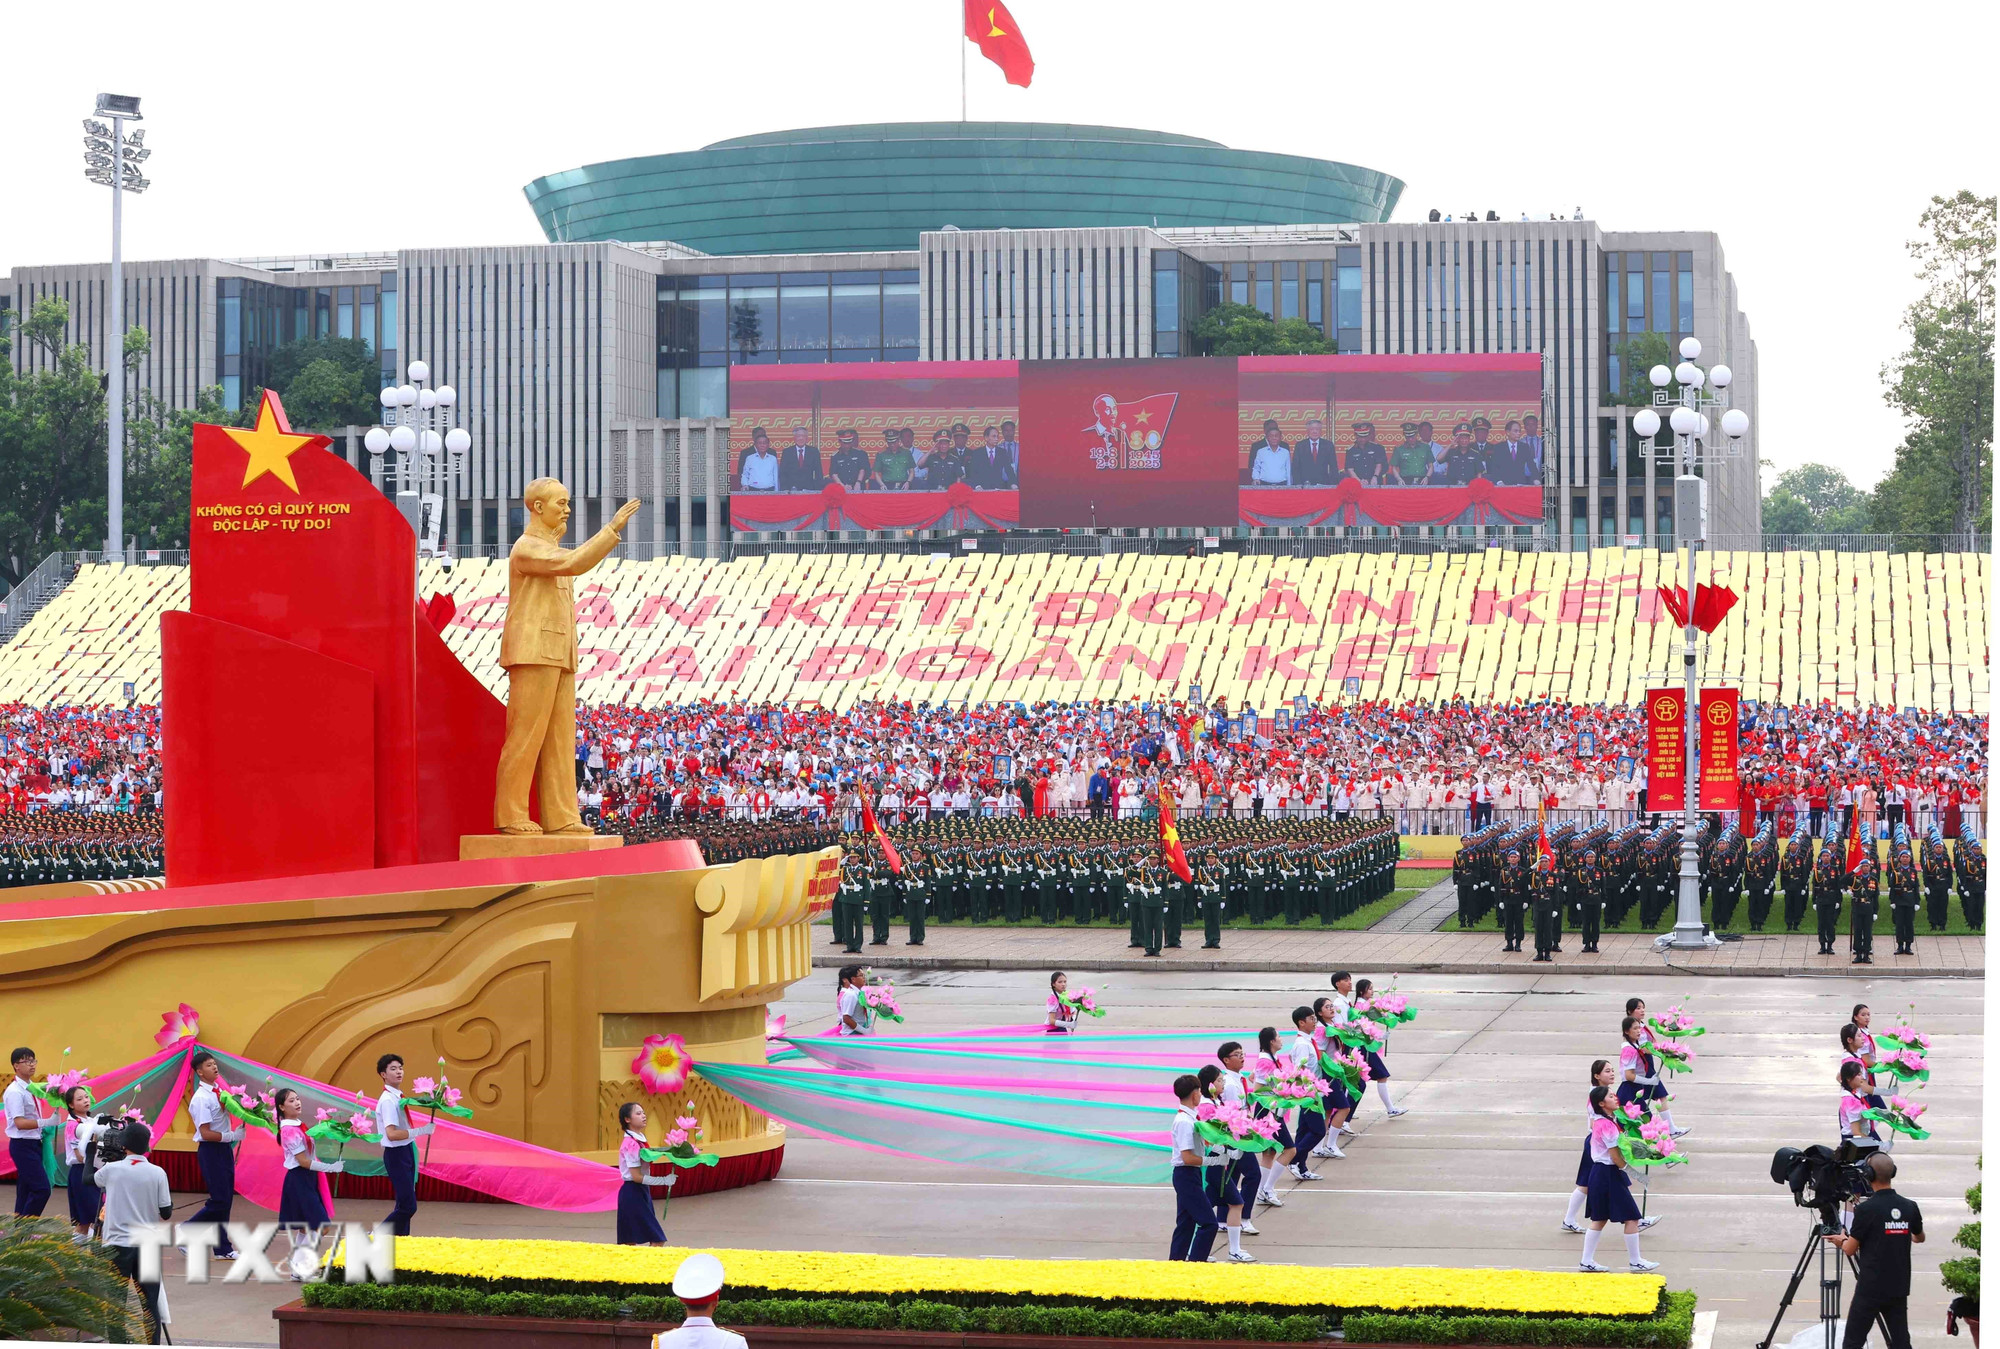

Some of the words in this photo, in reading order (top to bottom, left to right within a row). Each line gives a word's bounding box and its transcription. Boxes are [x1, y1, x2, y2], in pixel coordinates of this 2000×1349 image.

[1130, 430, 1161, 450] 80
[1089, 447, 1118, 459] 19-8
[1129, 450, 1161, 460] 1945
[1096, 458, 1118, 469] 2-9
[1129, 459, 1161, 469] 2025
[196, 504, 242, 517] KHÔNG
[245, 503, 265, 516] CÓ
[268, 502, 281, 515] GÌ
[285, 501, 315, 515] QUÝ
[319, 503, 350, 514] HƠN
[213, 518, 241, 533] ĐỘC
[243, 518, 269, 533] LẬP
[280, 519, 300, 532] TỰ
[1032, 577, 1416, 627] ĐOÀN
[1466, 573, 1665, 625] KẾT
[793, 634, 1188, 682] ĐOÀN
[1238, 627, 1459, 681] KẾT
